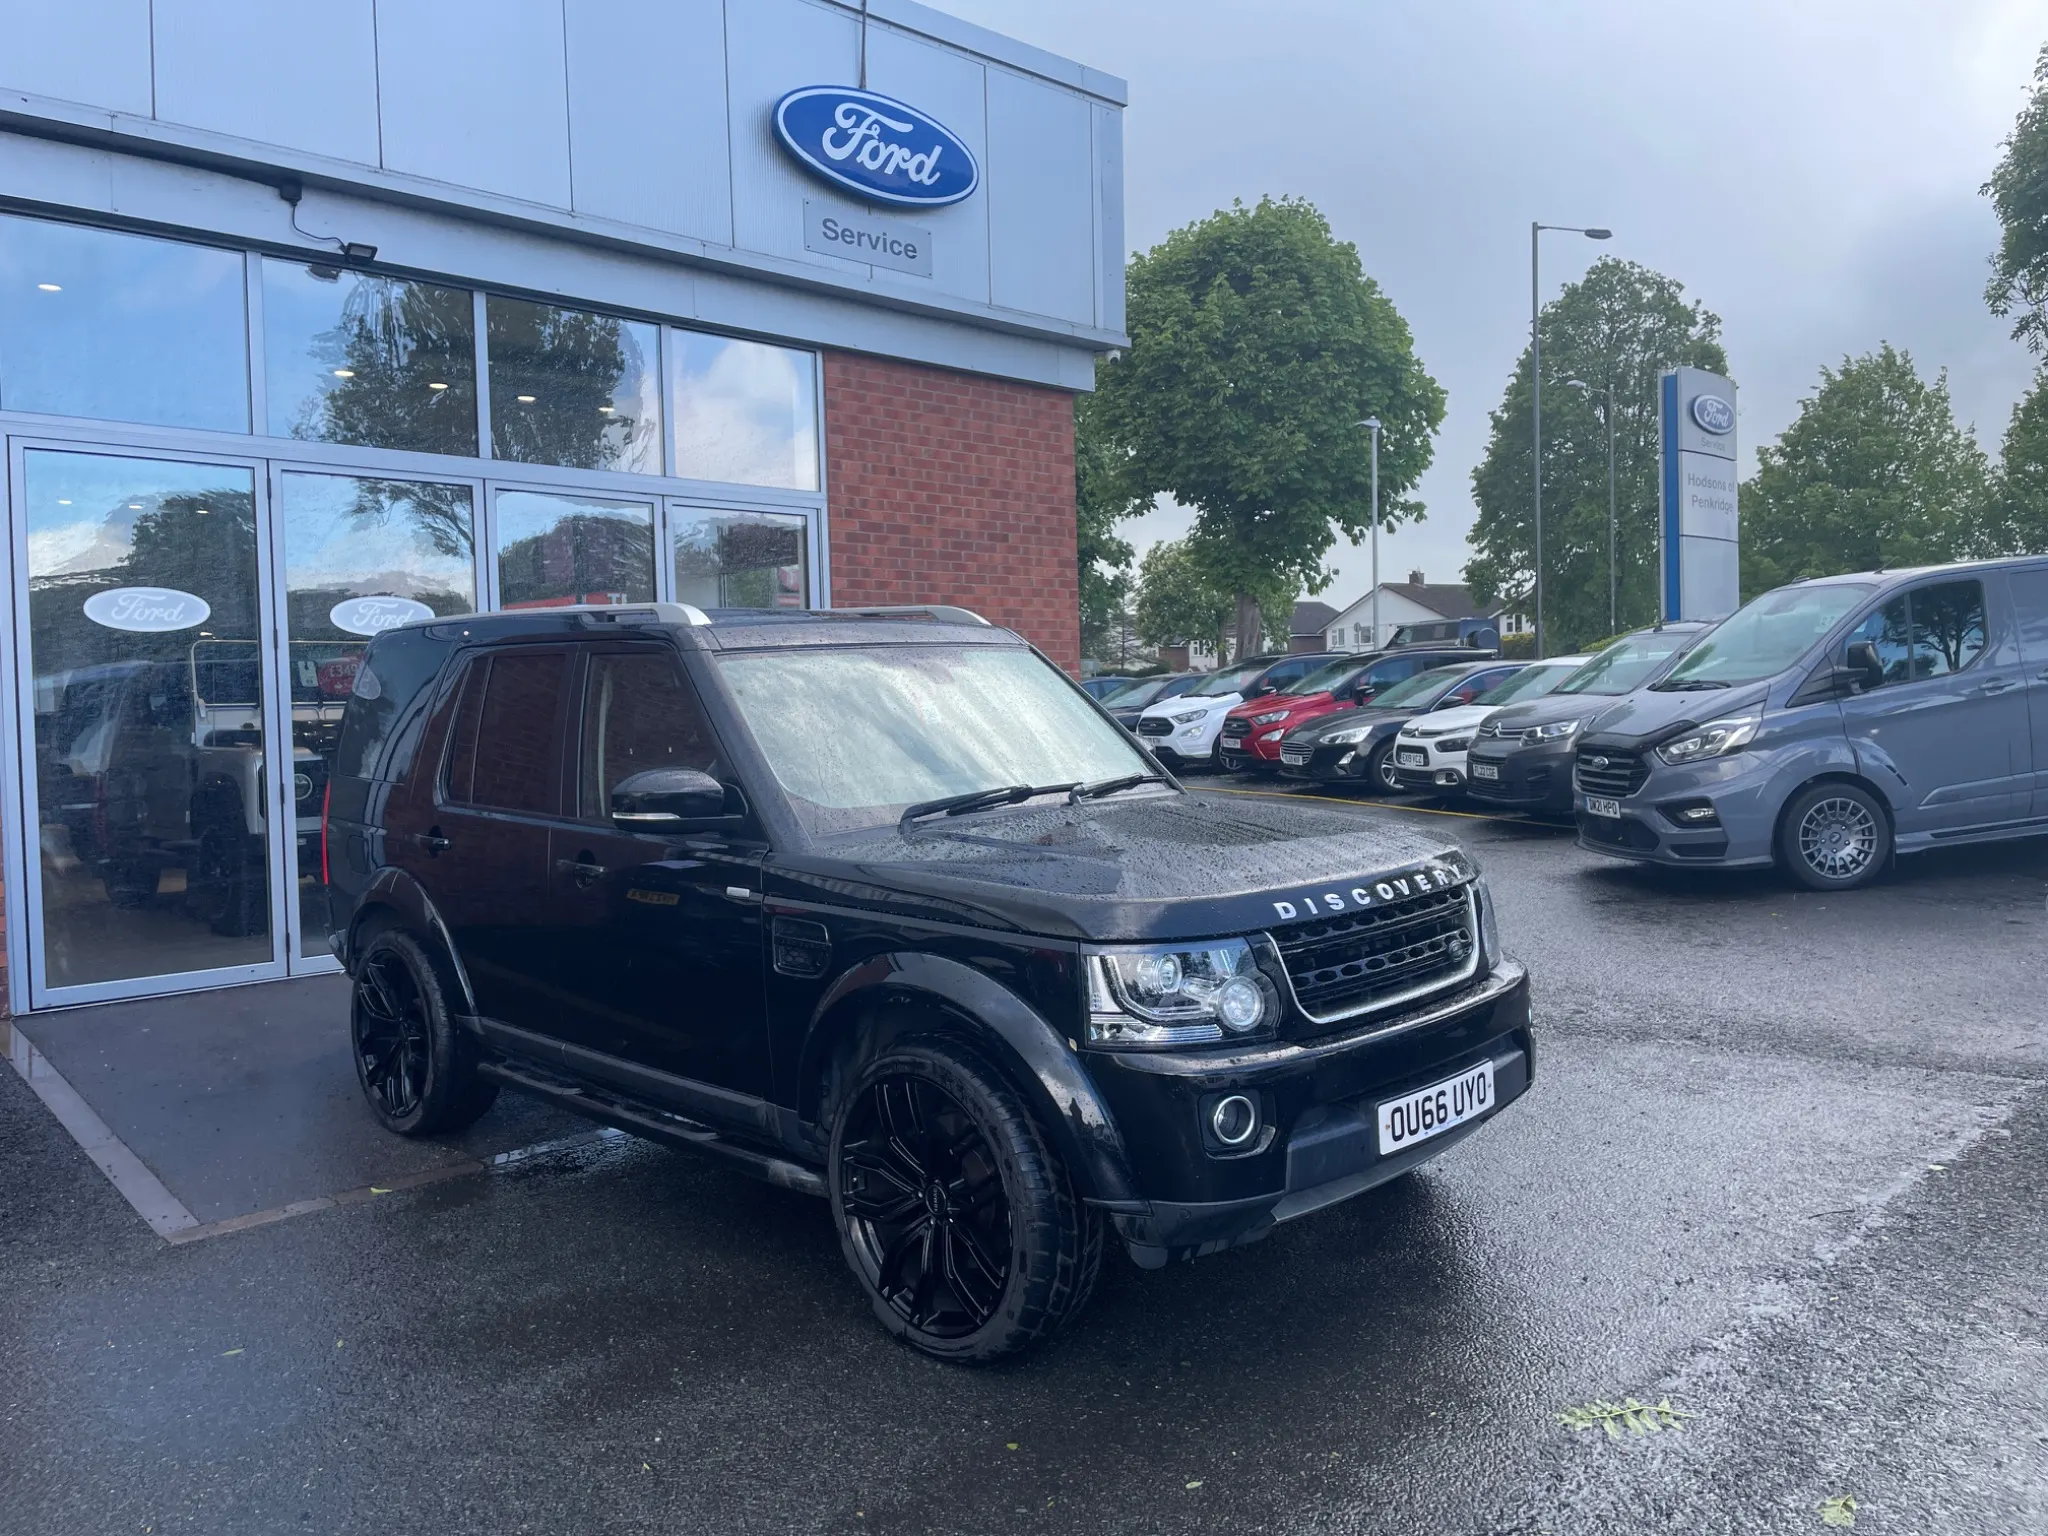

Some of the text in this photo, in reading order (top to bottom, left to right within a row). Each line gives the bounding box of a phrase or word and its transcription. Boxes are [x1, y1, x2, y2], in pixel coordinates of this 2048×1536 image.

[822, 102, 943, 185] Ford
[822, 218, 917, 260] Service
[1704, 400, 1729, 428] Ford
[1688, 472, 1726, 492] Hodsons
[1692, 494, 1733, 515] Penkridge
[111, 593, 185, 622] Ford
[353, 602, 415, 627] Ford
[1273, 864, 1462, 920] DISCOVERY
[1391, 1072, 1486, 1142] OU66 UYO
